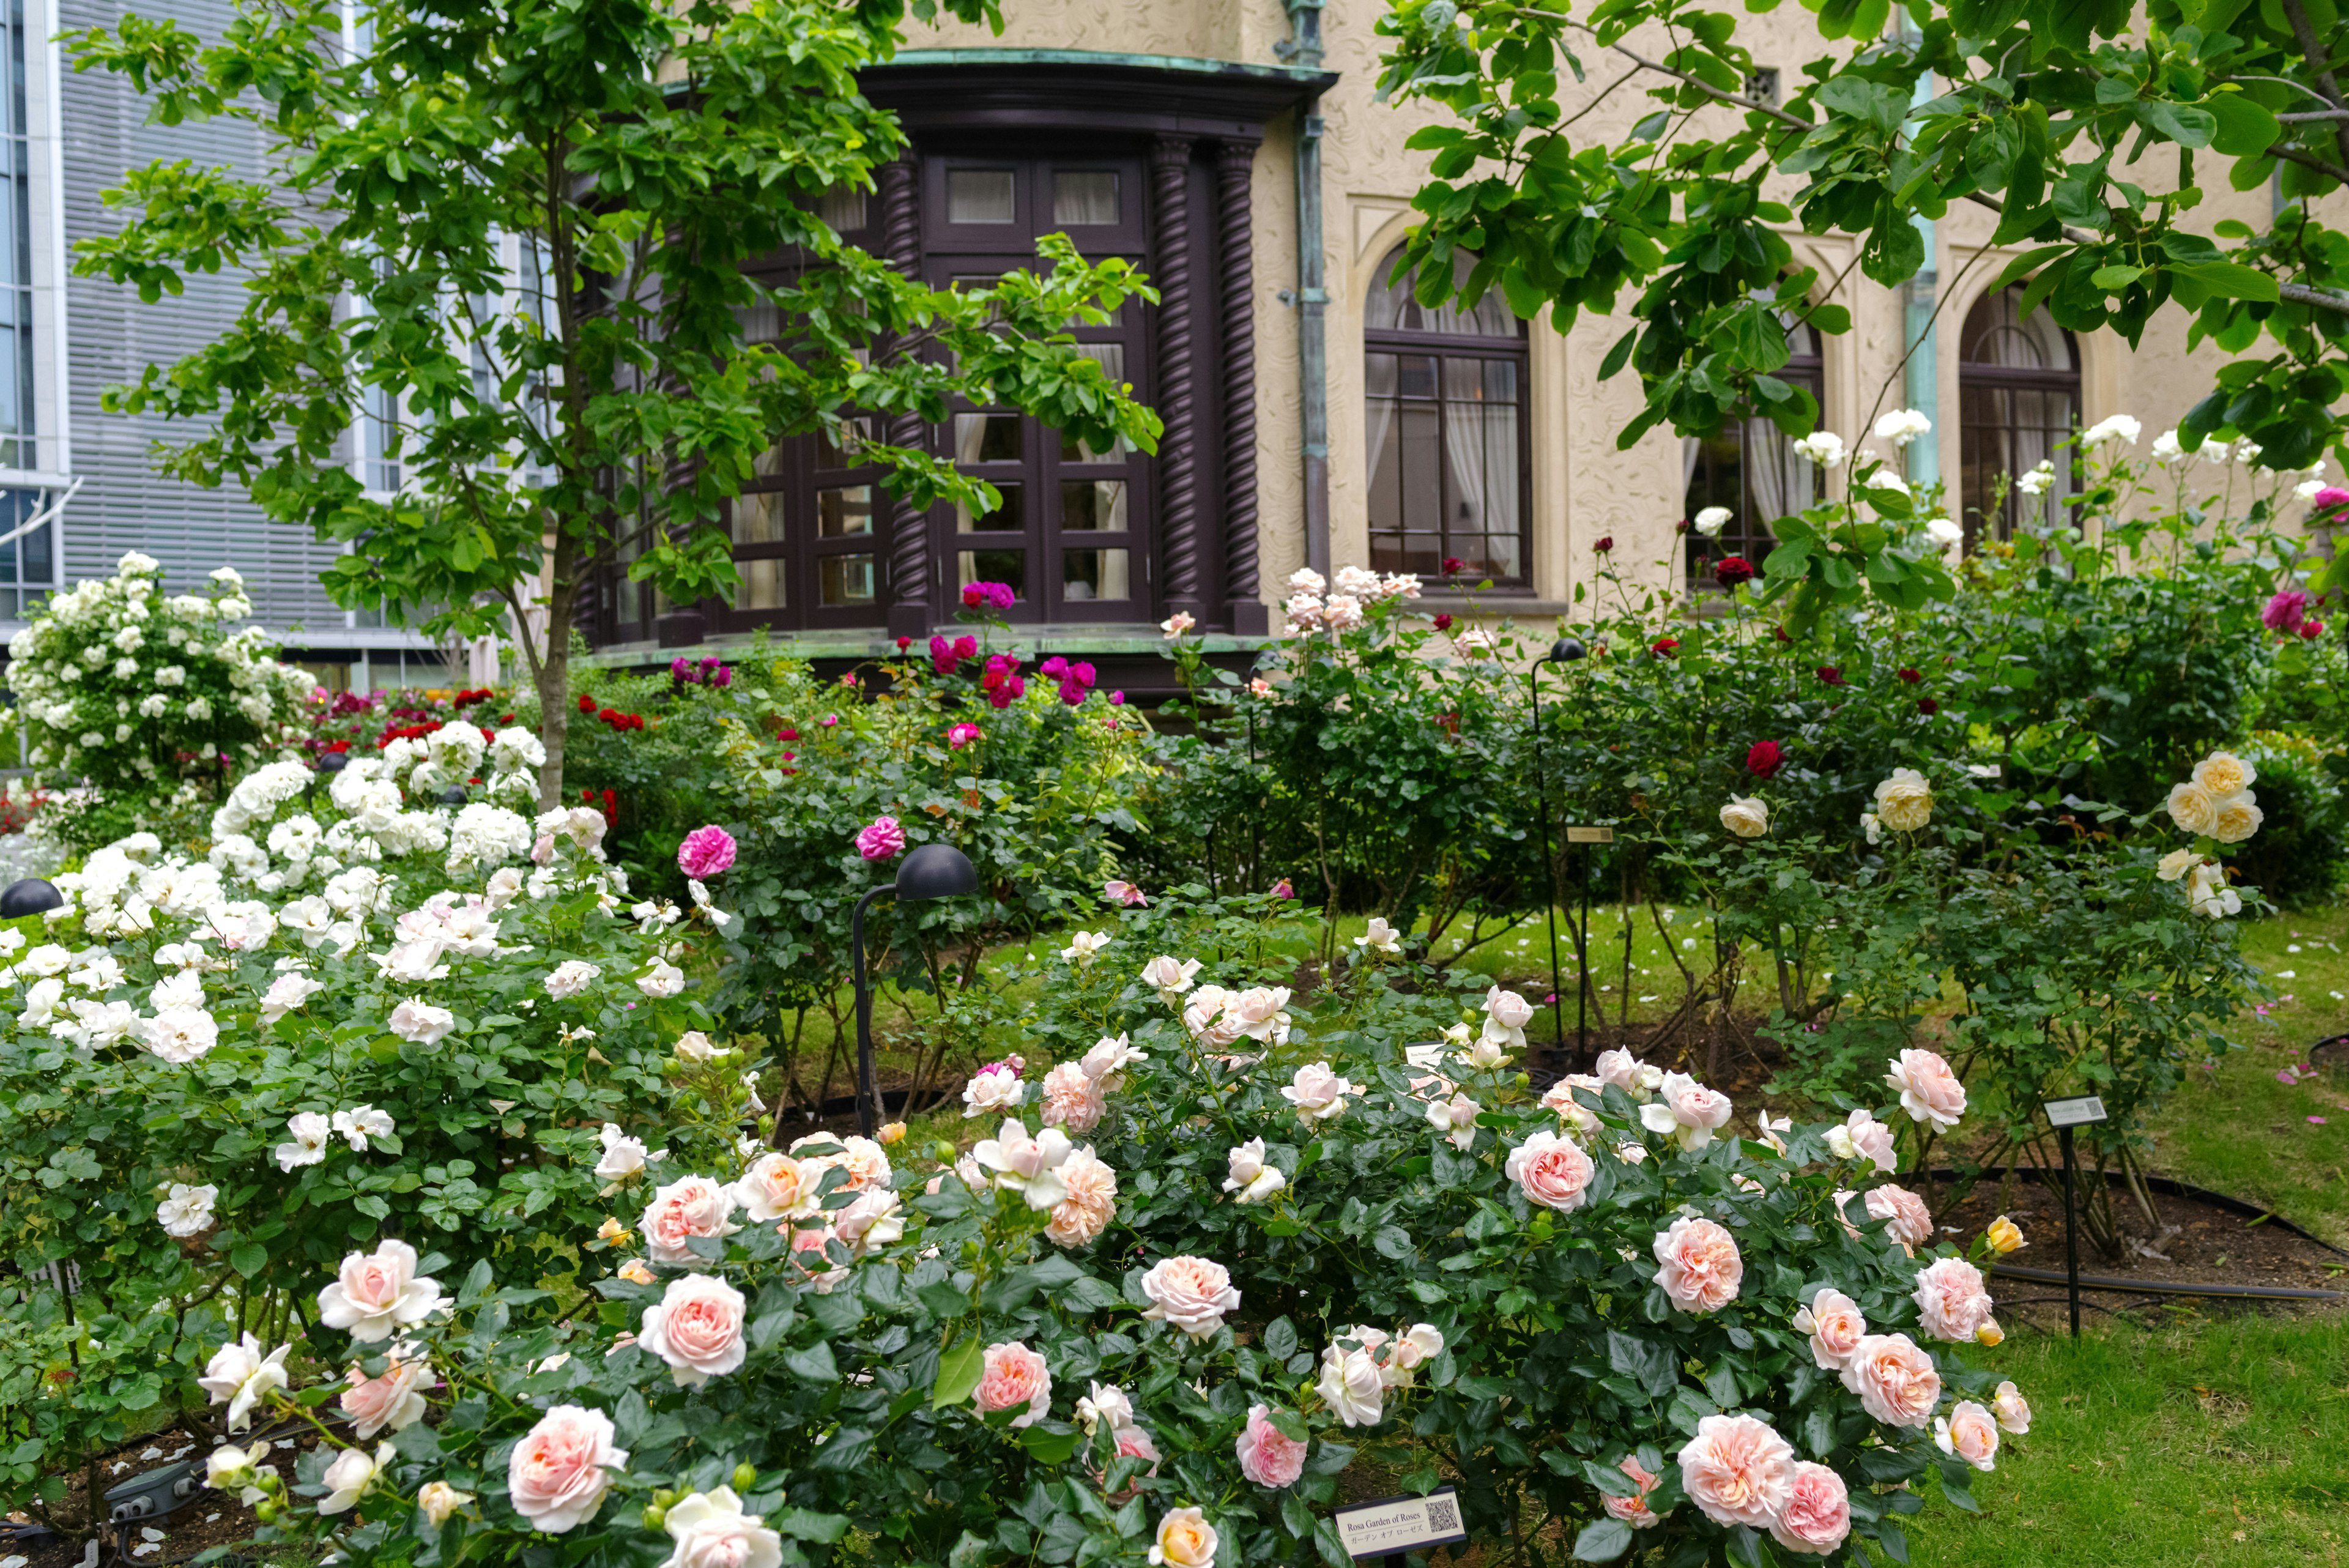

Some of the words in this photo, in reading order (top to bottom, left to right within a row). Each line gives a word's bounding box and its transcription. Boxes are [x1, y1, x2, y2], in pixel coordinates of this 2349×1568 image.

[1347, 1523, 1365, 1532] Rosa
[1365, 1518, 1390, 1528] Garden
[1392, 1515, 1399, 1523] of
[1400, 1512, 1420, 1521] Roses
[1351, 1534, 1377, 1545] ガーデン
